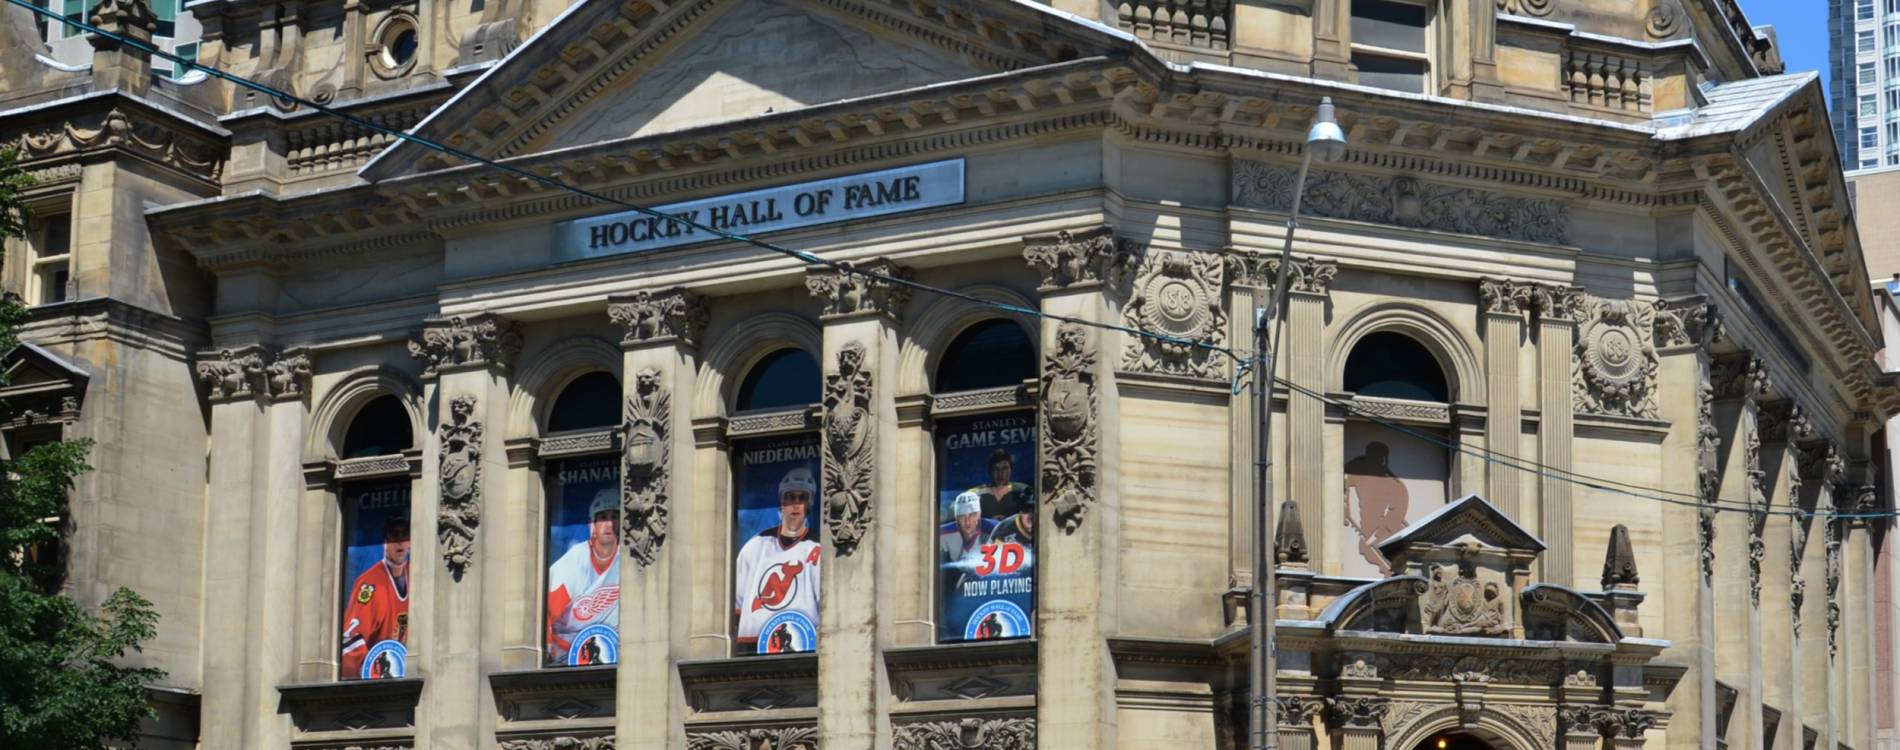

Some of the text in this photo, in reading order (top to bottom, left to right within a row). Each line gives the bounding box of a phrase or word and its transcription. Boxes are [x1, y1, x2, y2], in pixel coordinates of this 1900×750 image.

[590, 175, 921, 249] HOCKEY HALL OF FAME
[972, 417, 1027, 430] STANLEY'S
[946, 431, 996, 450] GAME
[358, 488, 411, 510] CHELI
[976, 543, 1025, 576] 3D
[963, 577, 1032, 597] NOW PLAYING
